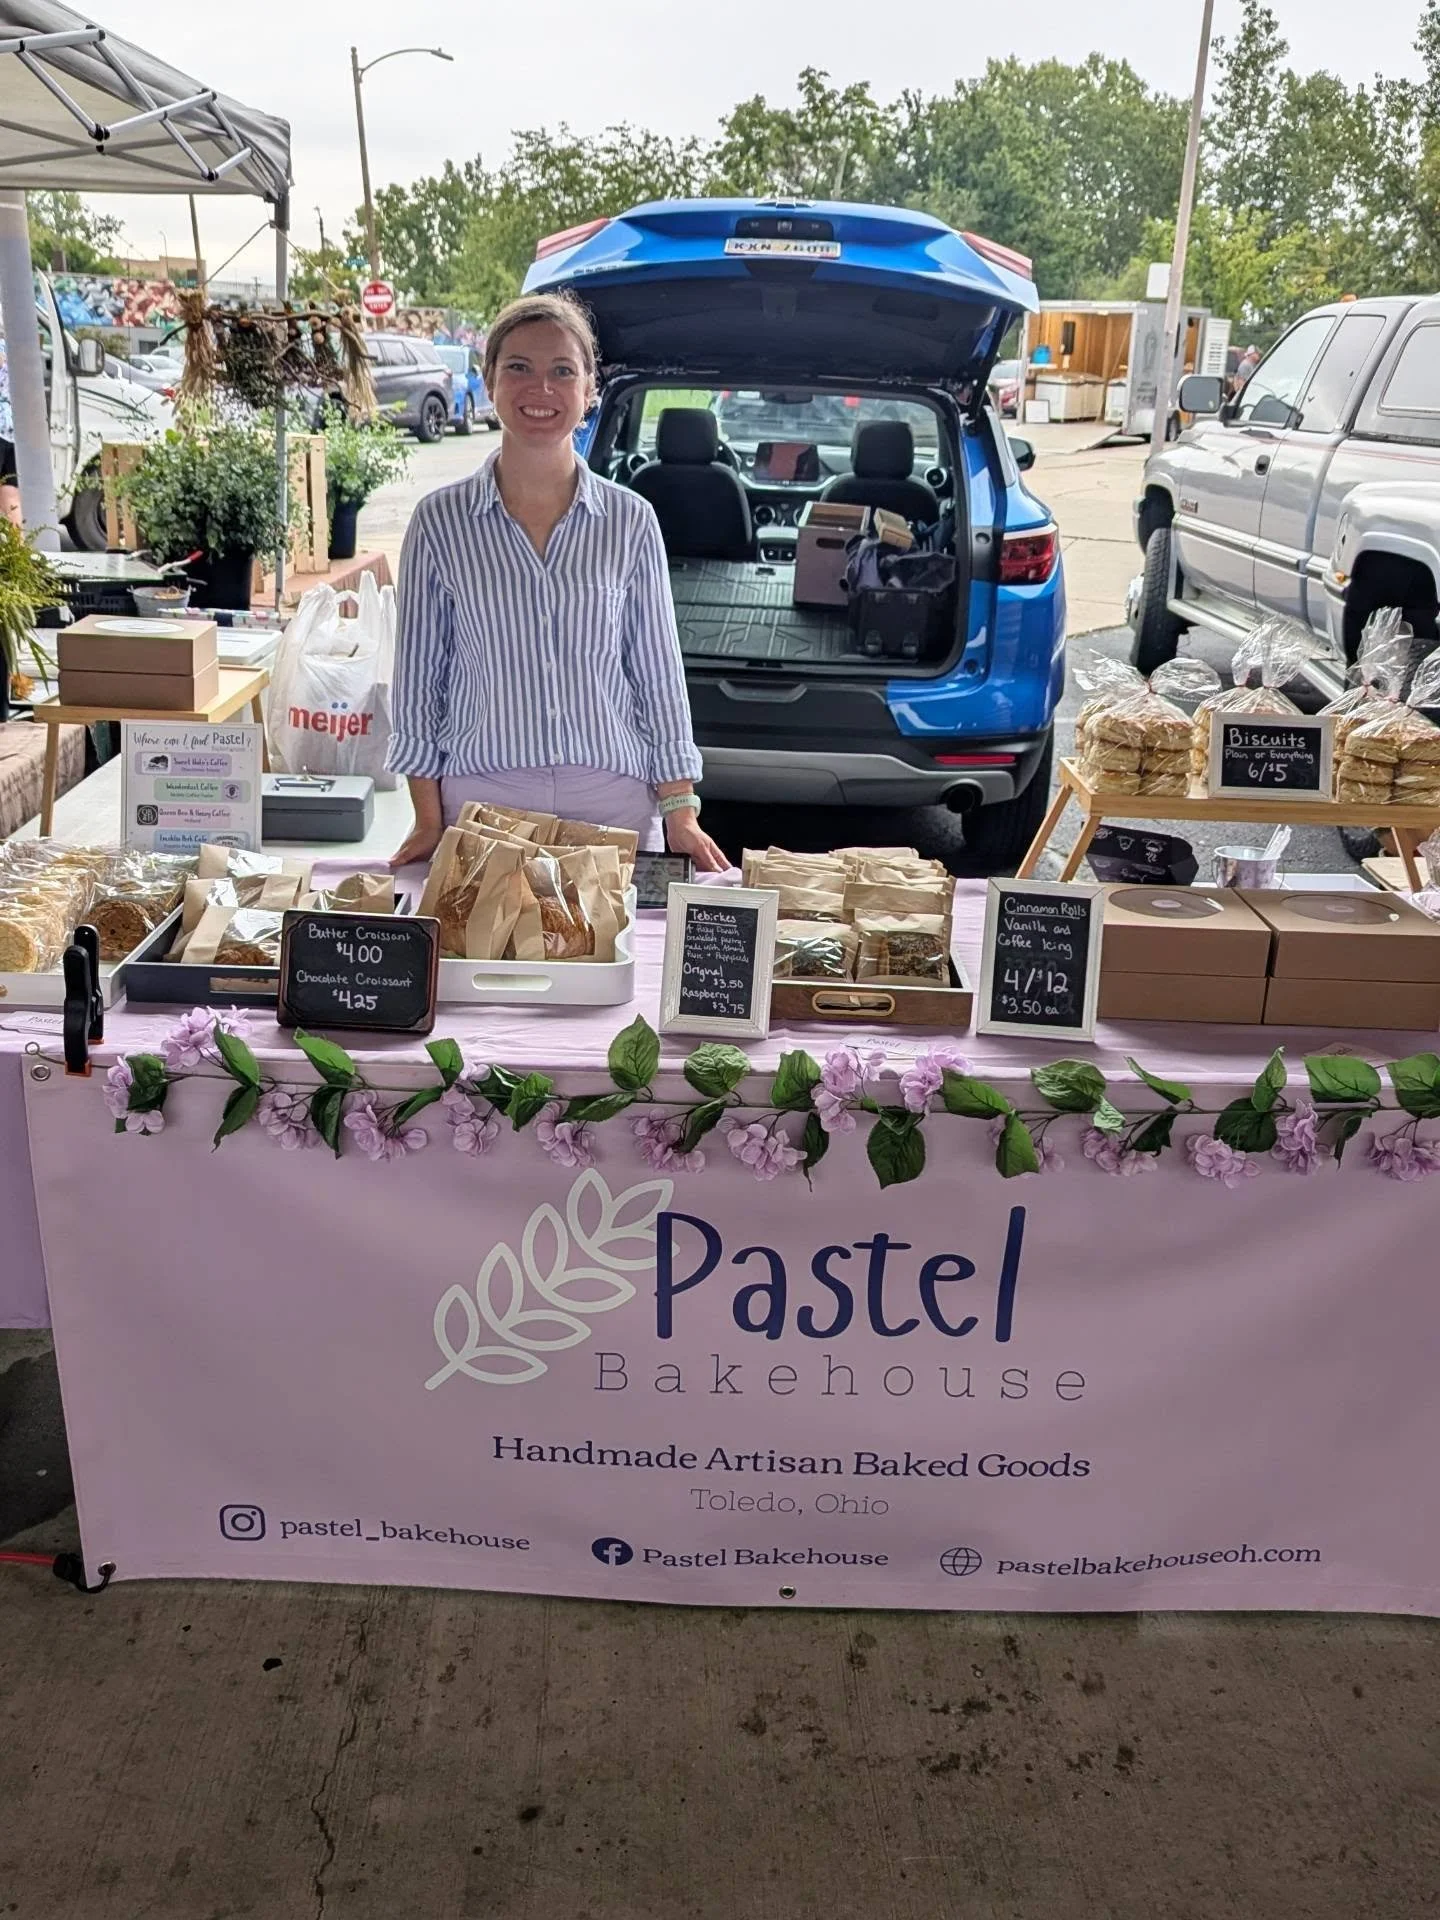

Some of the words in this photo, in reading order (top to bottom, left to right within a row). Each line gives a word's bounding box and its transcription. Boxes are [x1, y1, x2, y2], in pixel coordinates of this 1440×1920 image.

[289, 702, 373, 742] meijer
[164, 738, 178, 746] can
[191, 734, 209, 750] find
[213, 732, 244, 745] Pastel
[1229, 728, 1306, 748] Biscuits
[1225, 749, 1248, 759] Plain
[1270, 750, 1313, 764] Everything
[689, 908, 736, 923] Tebirkes
[1004, 897, 1059, 915] Cinnamon
[1061, 903, 1087, 918] Rolls
[308, 923, 348, 938] Butter
[356, 927, 411, 941] Croissant
[1004, 918, 1047, 933] Vanilla
[1054, 924, 1071, 935] and
[998, 933, 1032, 948] Coffee
[296, 970, 348, 985] Chocolate
[356, 973, 412, 987] Croissant
[682, 987, 729, 1003] Raspberry
[1002, 995, 1041, 1015] $3.50
[712, 1001, 744, 1014] $3.75
[654, 1205, 1027, 1342] Pastel
[594, 1351, 1086, 1401] Bakehouse
[493, 1436, 698, 1470] Handmade
[704, 1448, 843, 1475] Artisan
[852, 1451, 968, 1477] Baked
[978, 1453, 1091, 1478] Goods
[690, 1488, 803, 1516] Toledo,
[815, 1493, 889, 1515] Ohio
[280, 1518, 531, 1551] pastel_bakehouse
[643, 1548, 727, 1567] Pastel
[734, 1547, 889, 1566] Bakehouse
[997, 1544, 1322, 1575] pastelbakehouseoh.com
